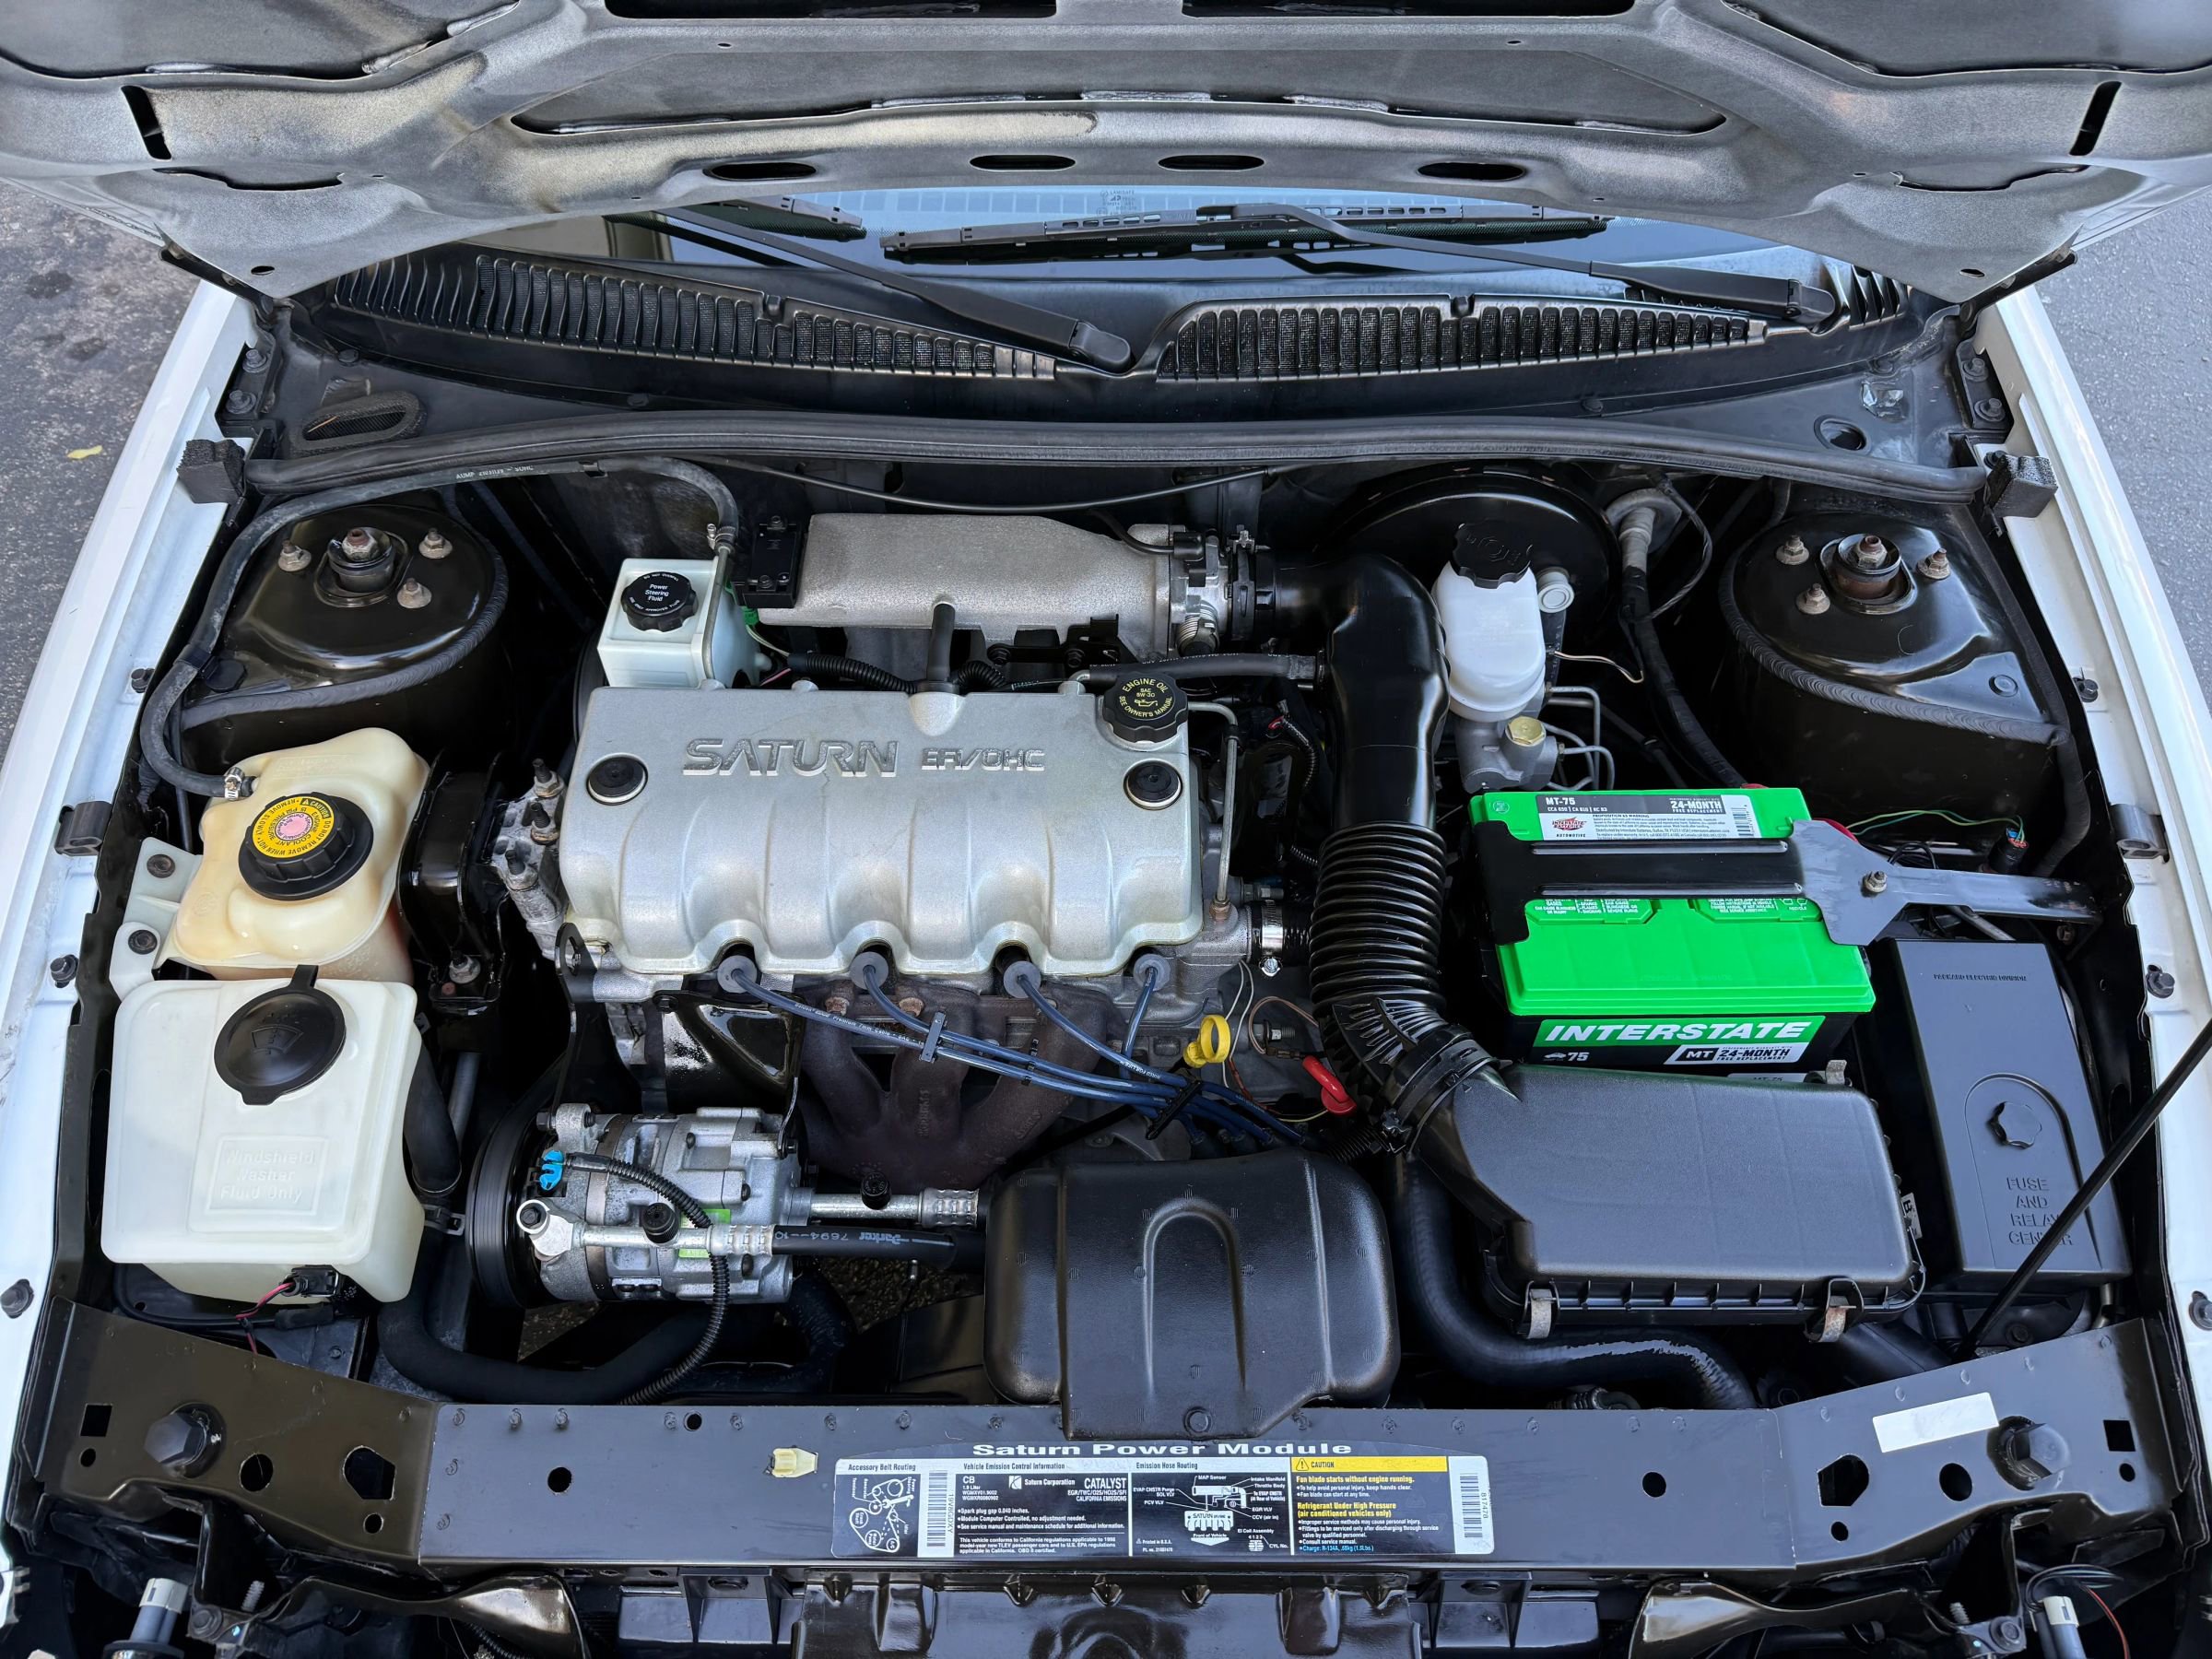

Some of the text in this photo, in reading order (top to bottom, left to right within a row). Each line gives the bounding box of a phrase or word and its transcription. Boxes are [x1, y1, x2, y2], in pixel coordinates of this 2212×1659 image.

[1123, 678, 1169, 693] ENGINE OIL
[1124, 705, 1153, 717] OWNER'S
[1155, 697, 1172, 715] MANUAL
[683, 738, 1045, 778] SATURN EFI/OHC
[269, 799, 296, 814] REMOVE
[1546, 797, 1575, 806] MT-75
[1670, 801, 1722, 809] 24-MONTH
[310, 801, 331, 818] CAUTION
[256, 815, 269, 835] SLOWLY
[324, 820, 331, 829] DO
[275, 834, 312, 846] COOLANT
[317, 830, 327, 839] NOT
[266, 846, 287, 855] WHEN
[288, 841, 317, 854] REMOVE
[832, 1016, 856, 1026] Premium
[1544, 1021, 1813, 1041] INTERSTATE
[1568, 1052, 1590, 1062] 75
[2006, 1177, 2050, 1192] FUSE
[221, 1184, 302, 1204] Fluid Only
[2016, 1194, 2049, 1209] AND
[859, 1232, 900, 1244] Parker
[2008, 1230, 2073, 1245] CENR
[972, 1443, 1352, 1455] Saturn Power Module
[849, 1464, 878, 1472] Accessory
[1177, 1462, 1197, 1470] Routing
[1084, 1477, 1126, 1488] CATALYST
